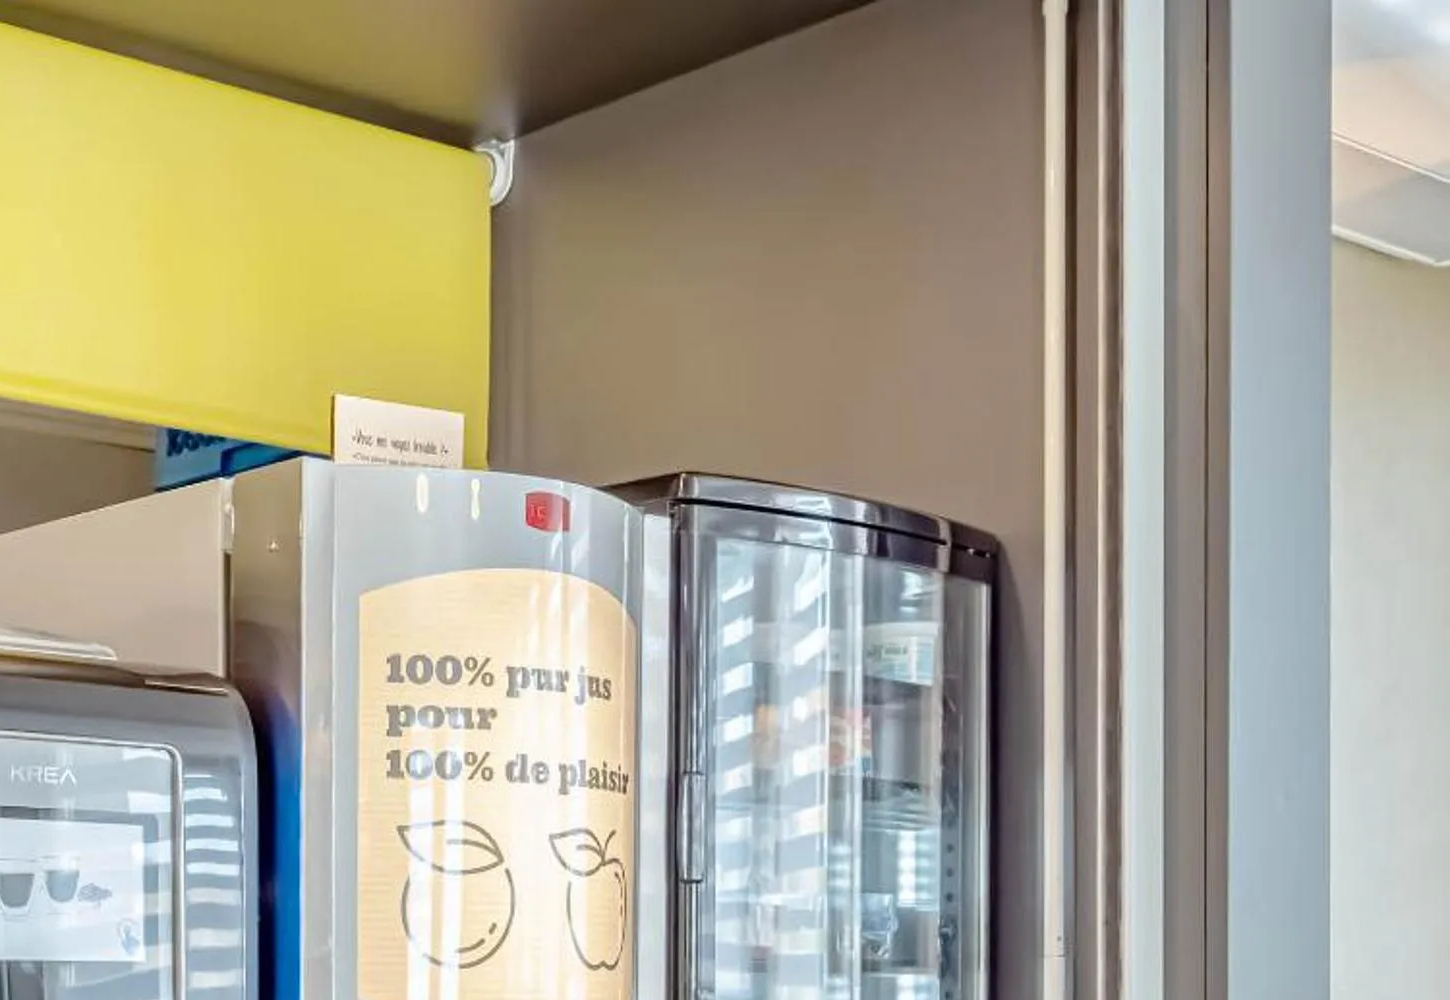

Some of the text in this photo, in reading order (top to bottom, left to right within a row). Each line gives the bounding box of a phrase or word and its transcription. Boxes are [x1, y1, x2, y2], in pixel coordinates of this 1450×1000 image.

[386, 653, 612, 706] 100% pur jus
[386, 703, 497, 737] pour
[386, 749, 629, 795] 100% de plaisir
